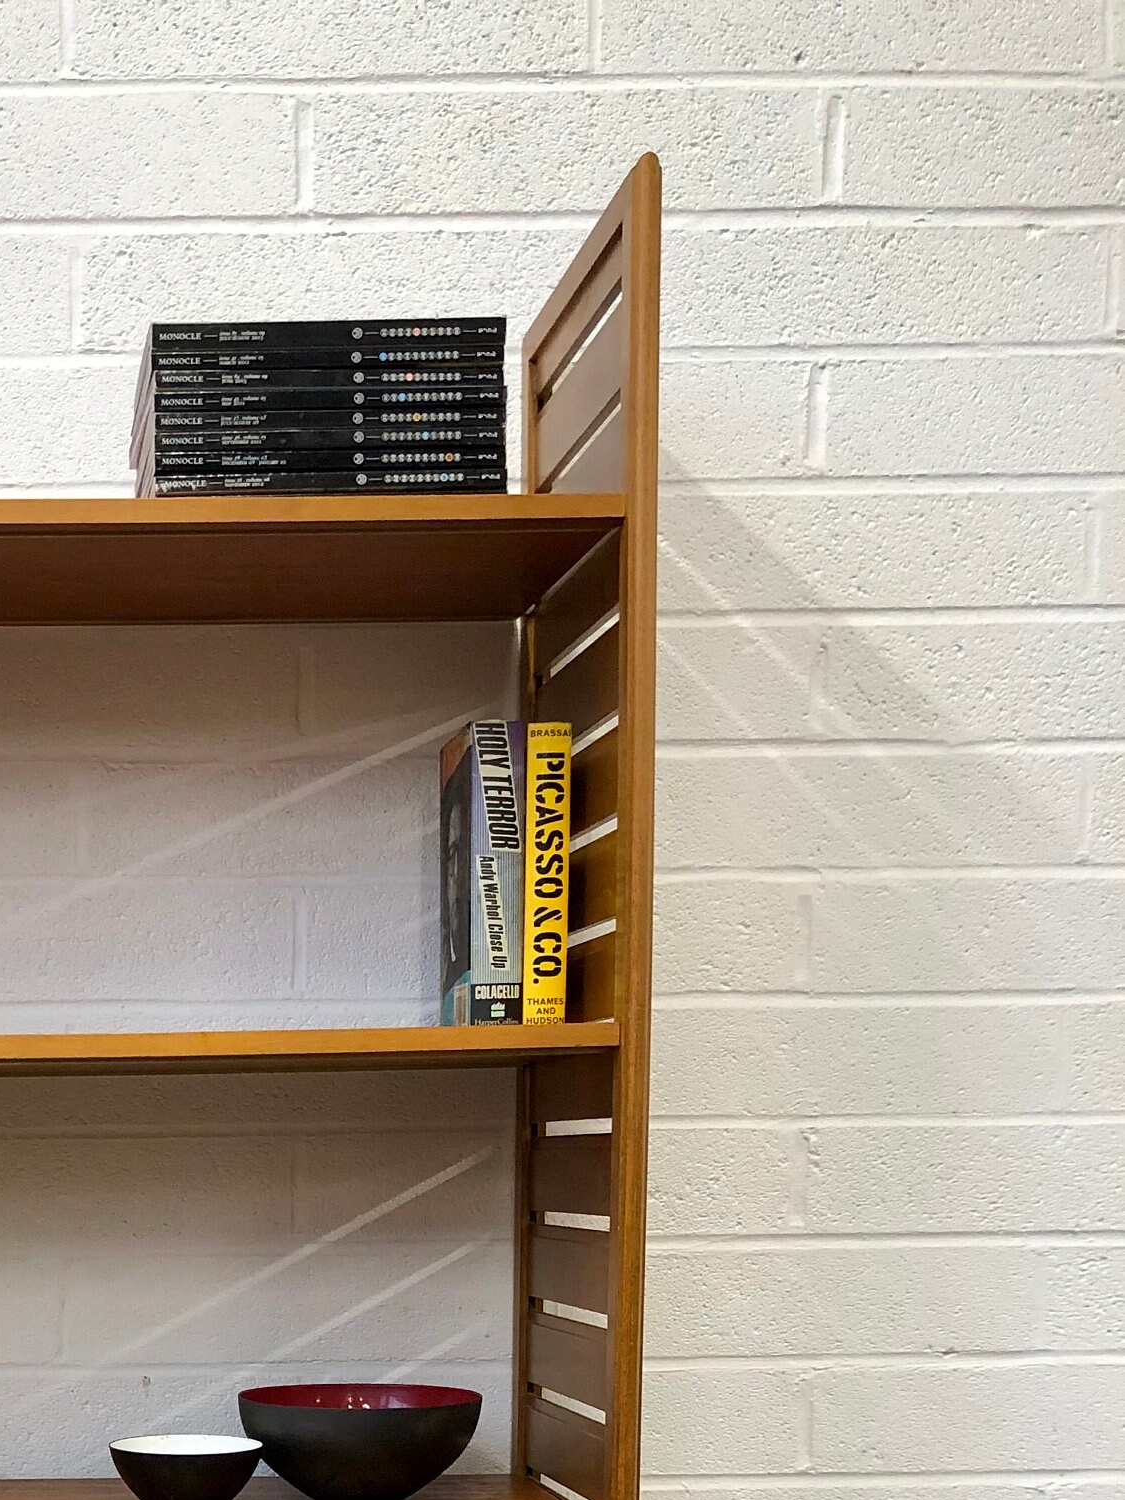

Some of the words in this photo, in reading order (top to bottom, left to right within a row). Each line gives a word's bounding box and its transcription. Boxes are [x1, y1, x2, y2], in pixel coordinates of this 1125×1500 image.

[158, 357, 201, 365] MONOCLE
[161, 398, 204, 406] MONOCLE
[160, 417, 203, 425] MONOCLE
[162, 436, 204, 445] MONOCLE
[162, 457, 204, 465] MONOCLE
[475, 723, 510, 769] HOLY
[482, 775, 520, 849] TERROR
[534, 752, 565, 898] PICASSO
[479, 856, 496, 880] Andy
[483, 883, 502, 920] Warhol
[533, 907, 562, 927] &
[488, 924, 504, 952] Close
[491, 956, 508, 968] Up
[533, 932, 562, 984] CO.
[475, 985, 520, 999] COLACELLO
